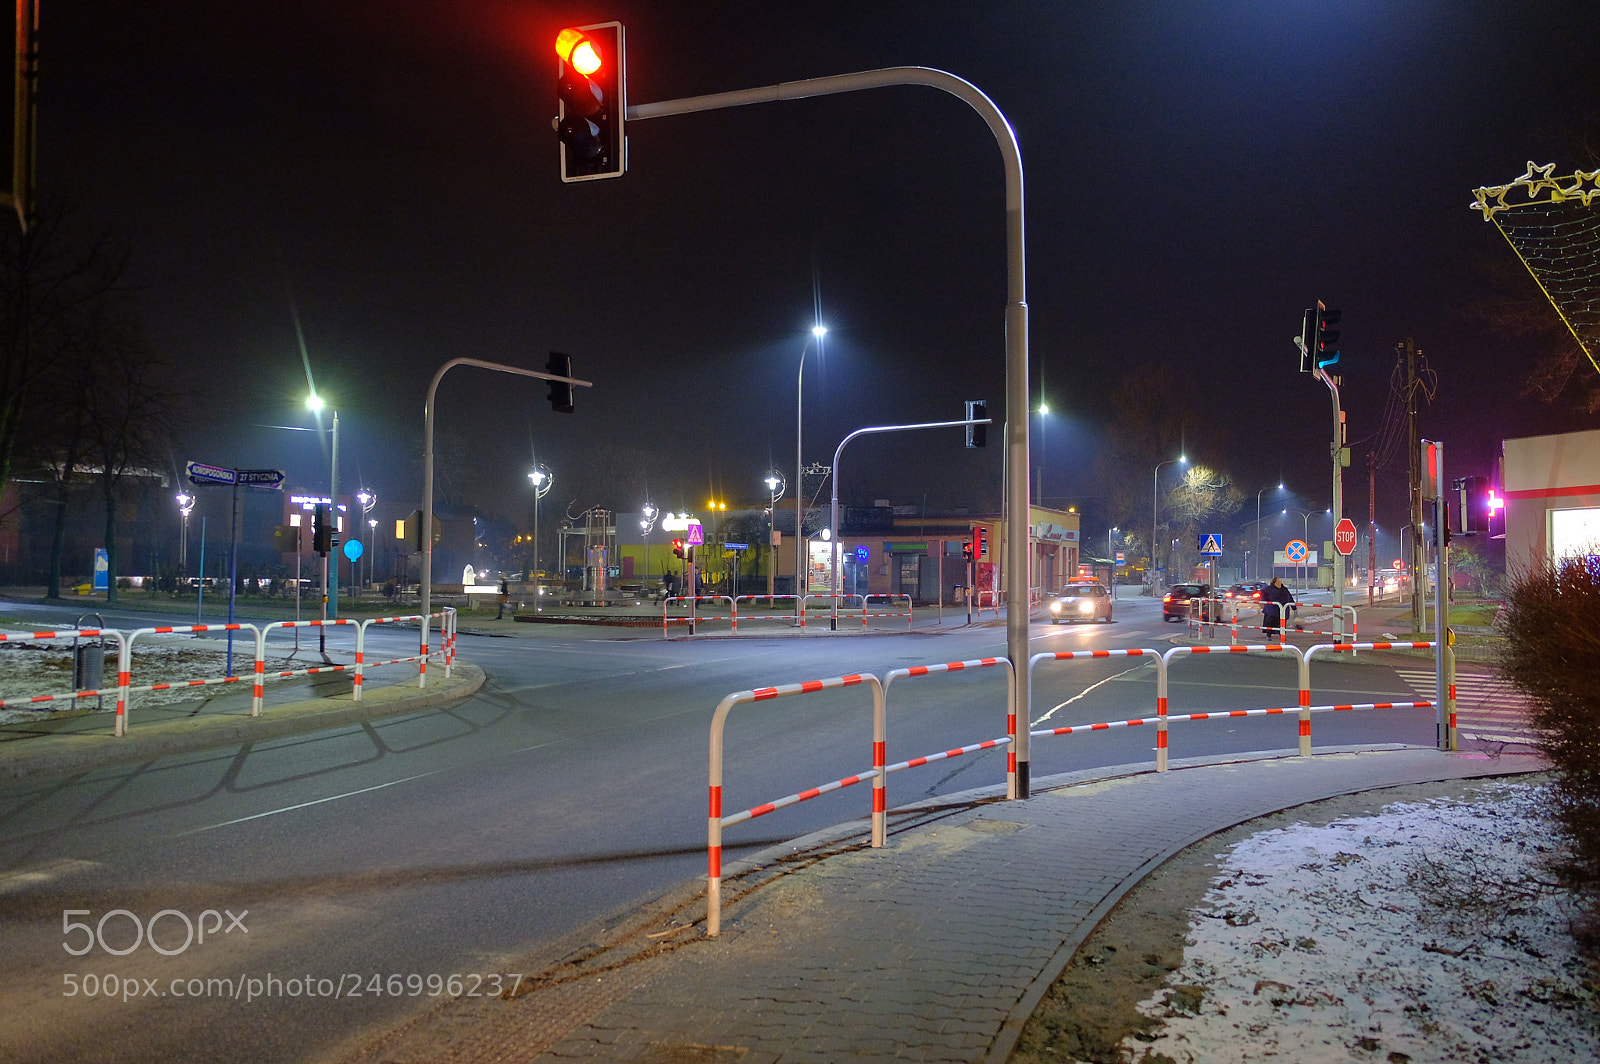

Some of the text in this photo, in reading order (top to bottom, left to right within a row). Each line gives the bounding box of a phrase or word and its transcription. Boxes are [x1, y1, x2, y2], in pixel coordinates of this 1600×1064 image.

[239, 473, 279, 481] 27 STYCZNIA
[1337, 531, 1355, 542] STOP
